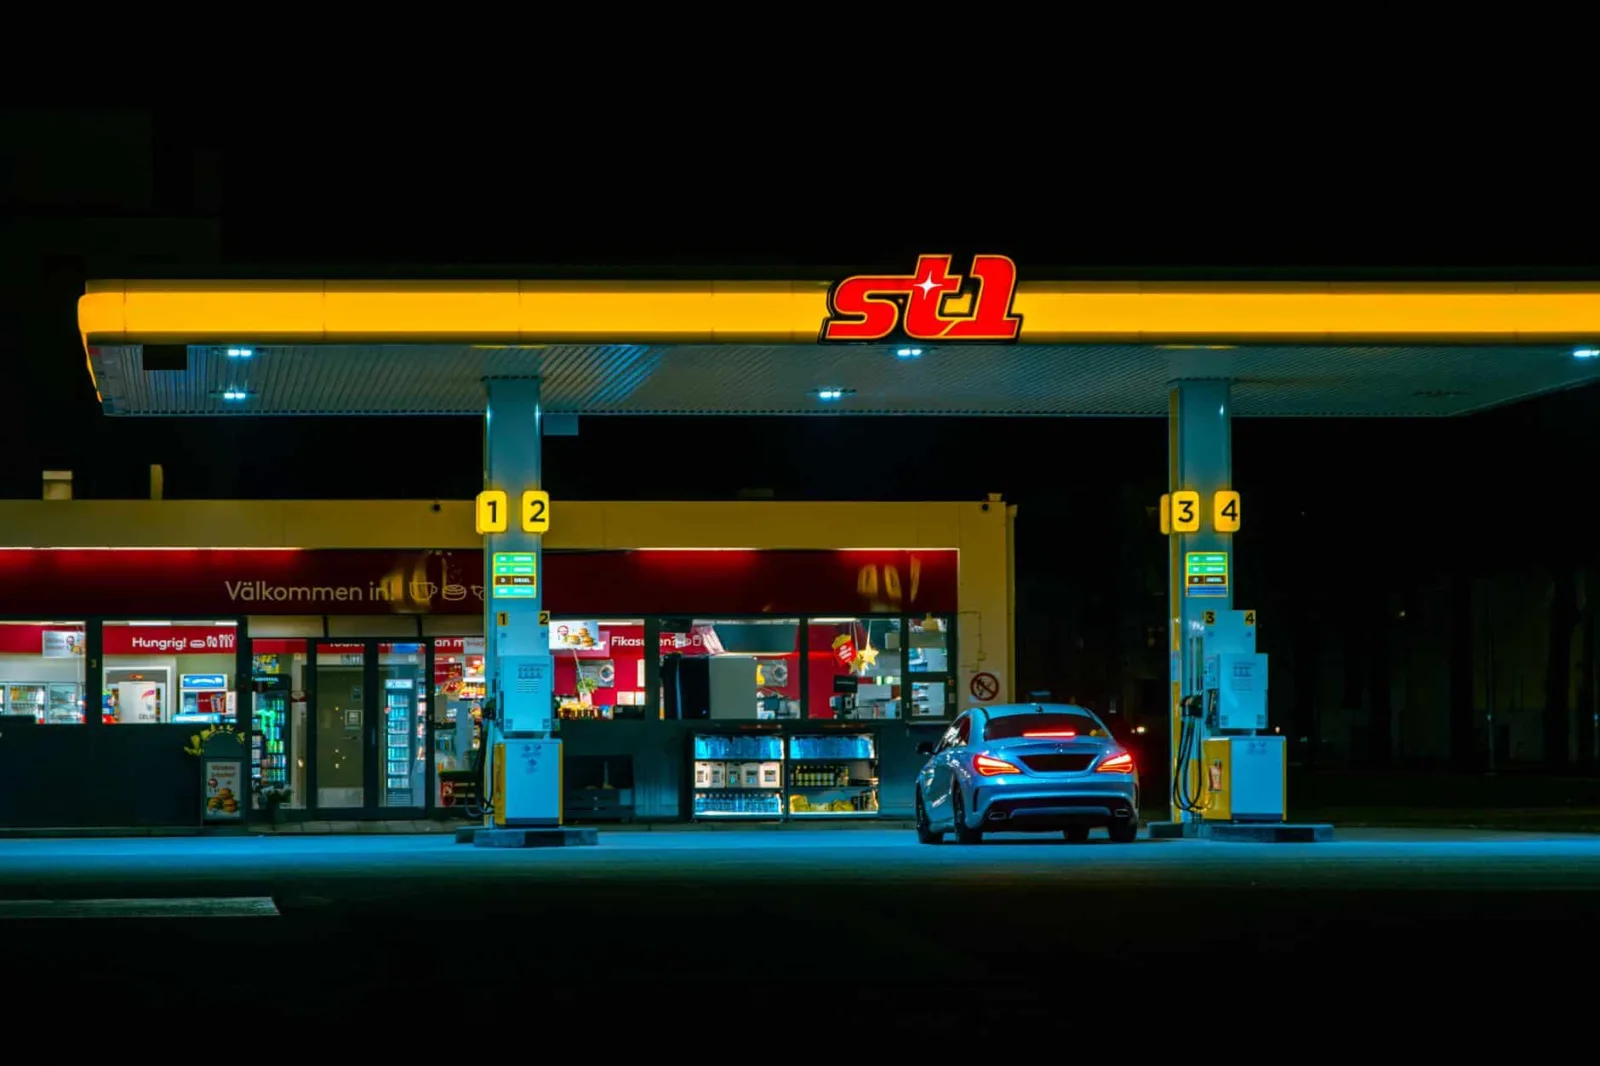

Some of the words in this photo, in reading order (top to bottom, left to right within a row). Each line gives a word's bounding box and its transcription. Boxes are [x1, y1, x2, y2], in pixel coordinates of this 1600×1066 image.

[824, 253, 1021, 340] st1
[487, 500, 497, 523] 1
[530, 500, 546, 523] 2
[1178, 500, 1194, 523] 3
[1221, 499, 1238, 522] 4
[224, 581, 363, 601] Välkommen
[369, 581, 395, 601] in!
[499, 613, 506, 625] 1
[539, 612, 549, 625] 2
[1205, 611, 1215, 624] 3
[1245, 612, 1255, 624] 4
[131, 637, 188, 651] Hungrig!
